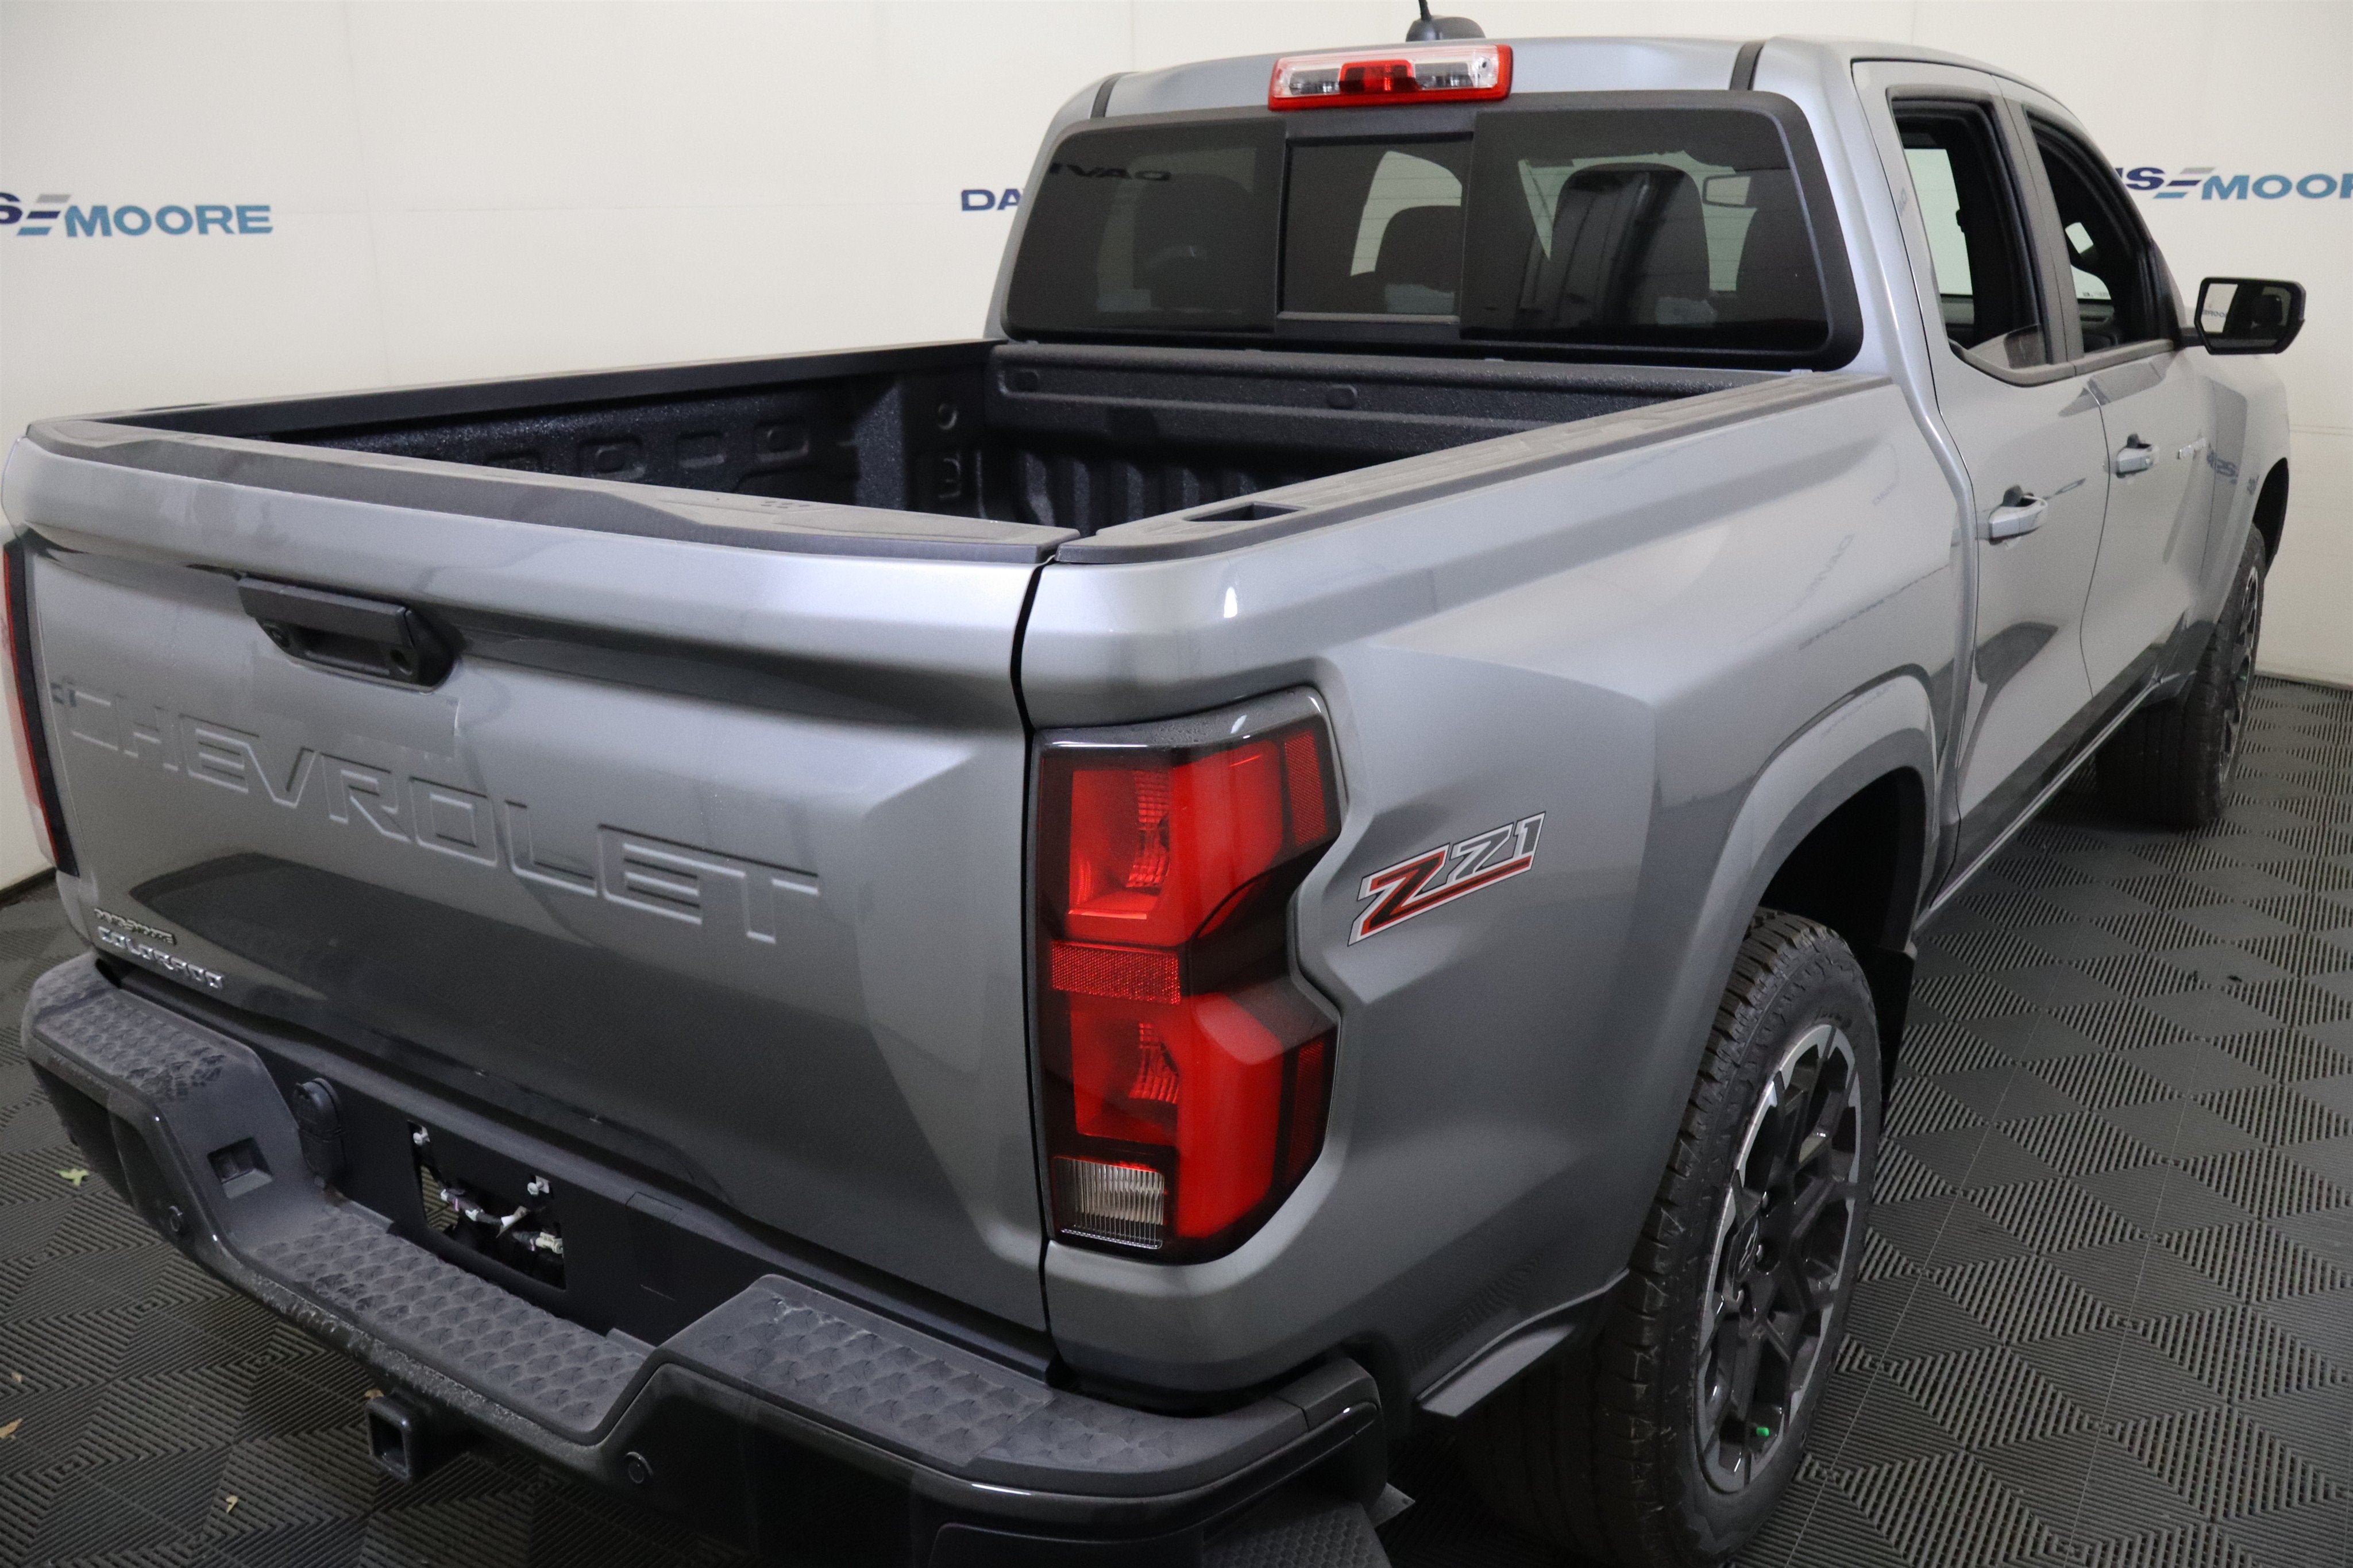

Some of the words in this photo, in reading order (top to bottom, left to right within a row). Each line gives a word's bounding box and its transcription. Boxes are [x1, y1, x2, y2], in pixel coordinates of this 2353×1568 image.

[64, 204, 273, 238] MOORE
[53, 678, 819, 944] CHEVROLET
[1347, 811, 1546, 947] Z71
[97, 925, 223, 990] COLORADO
